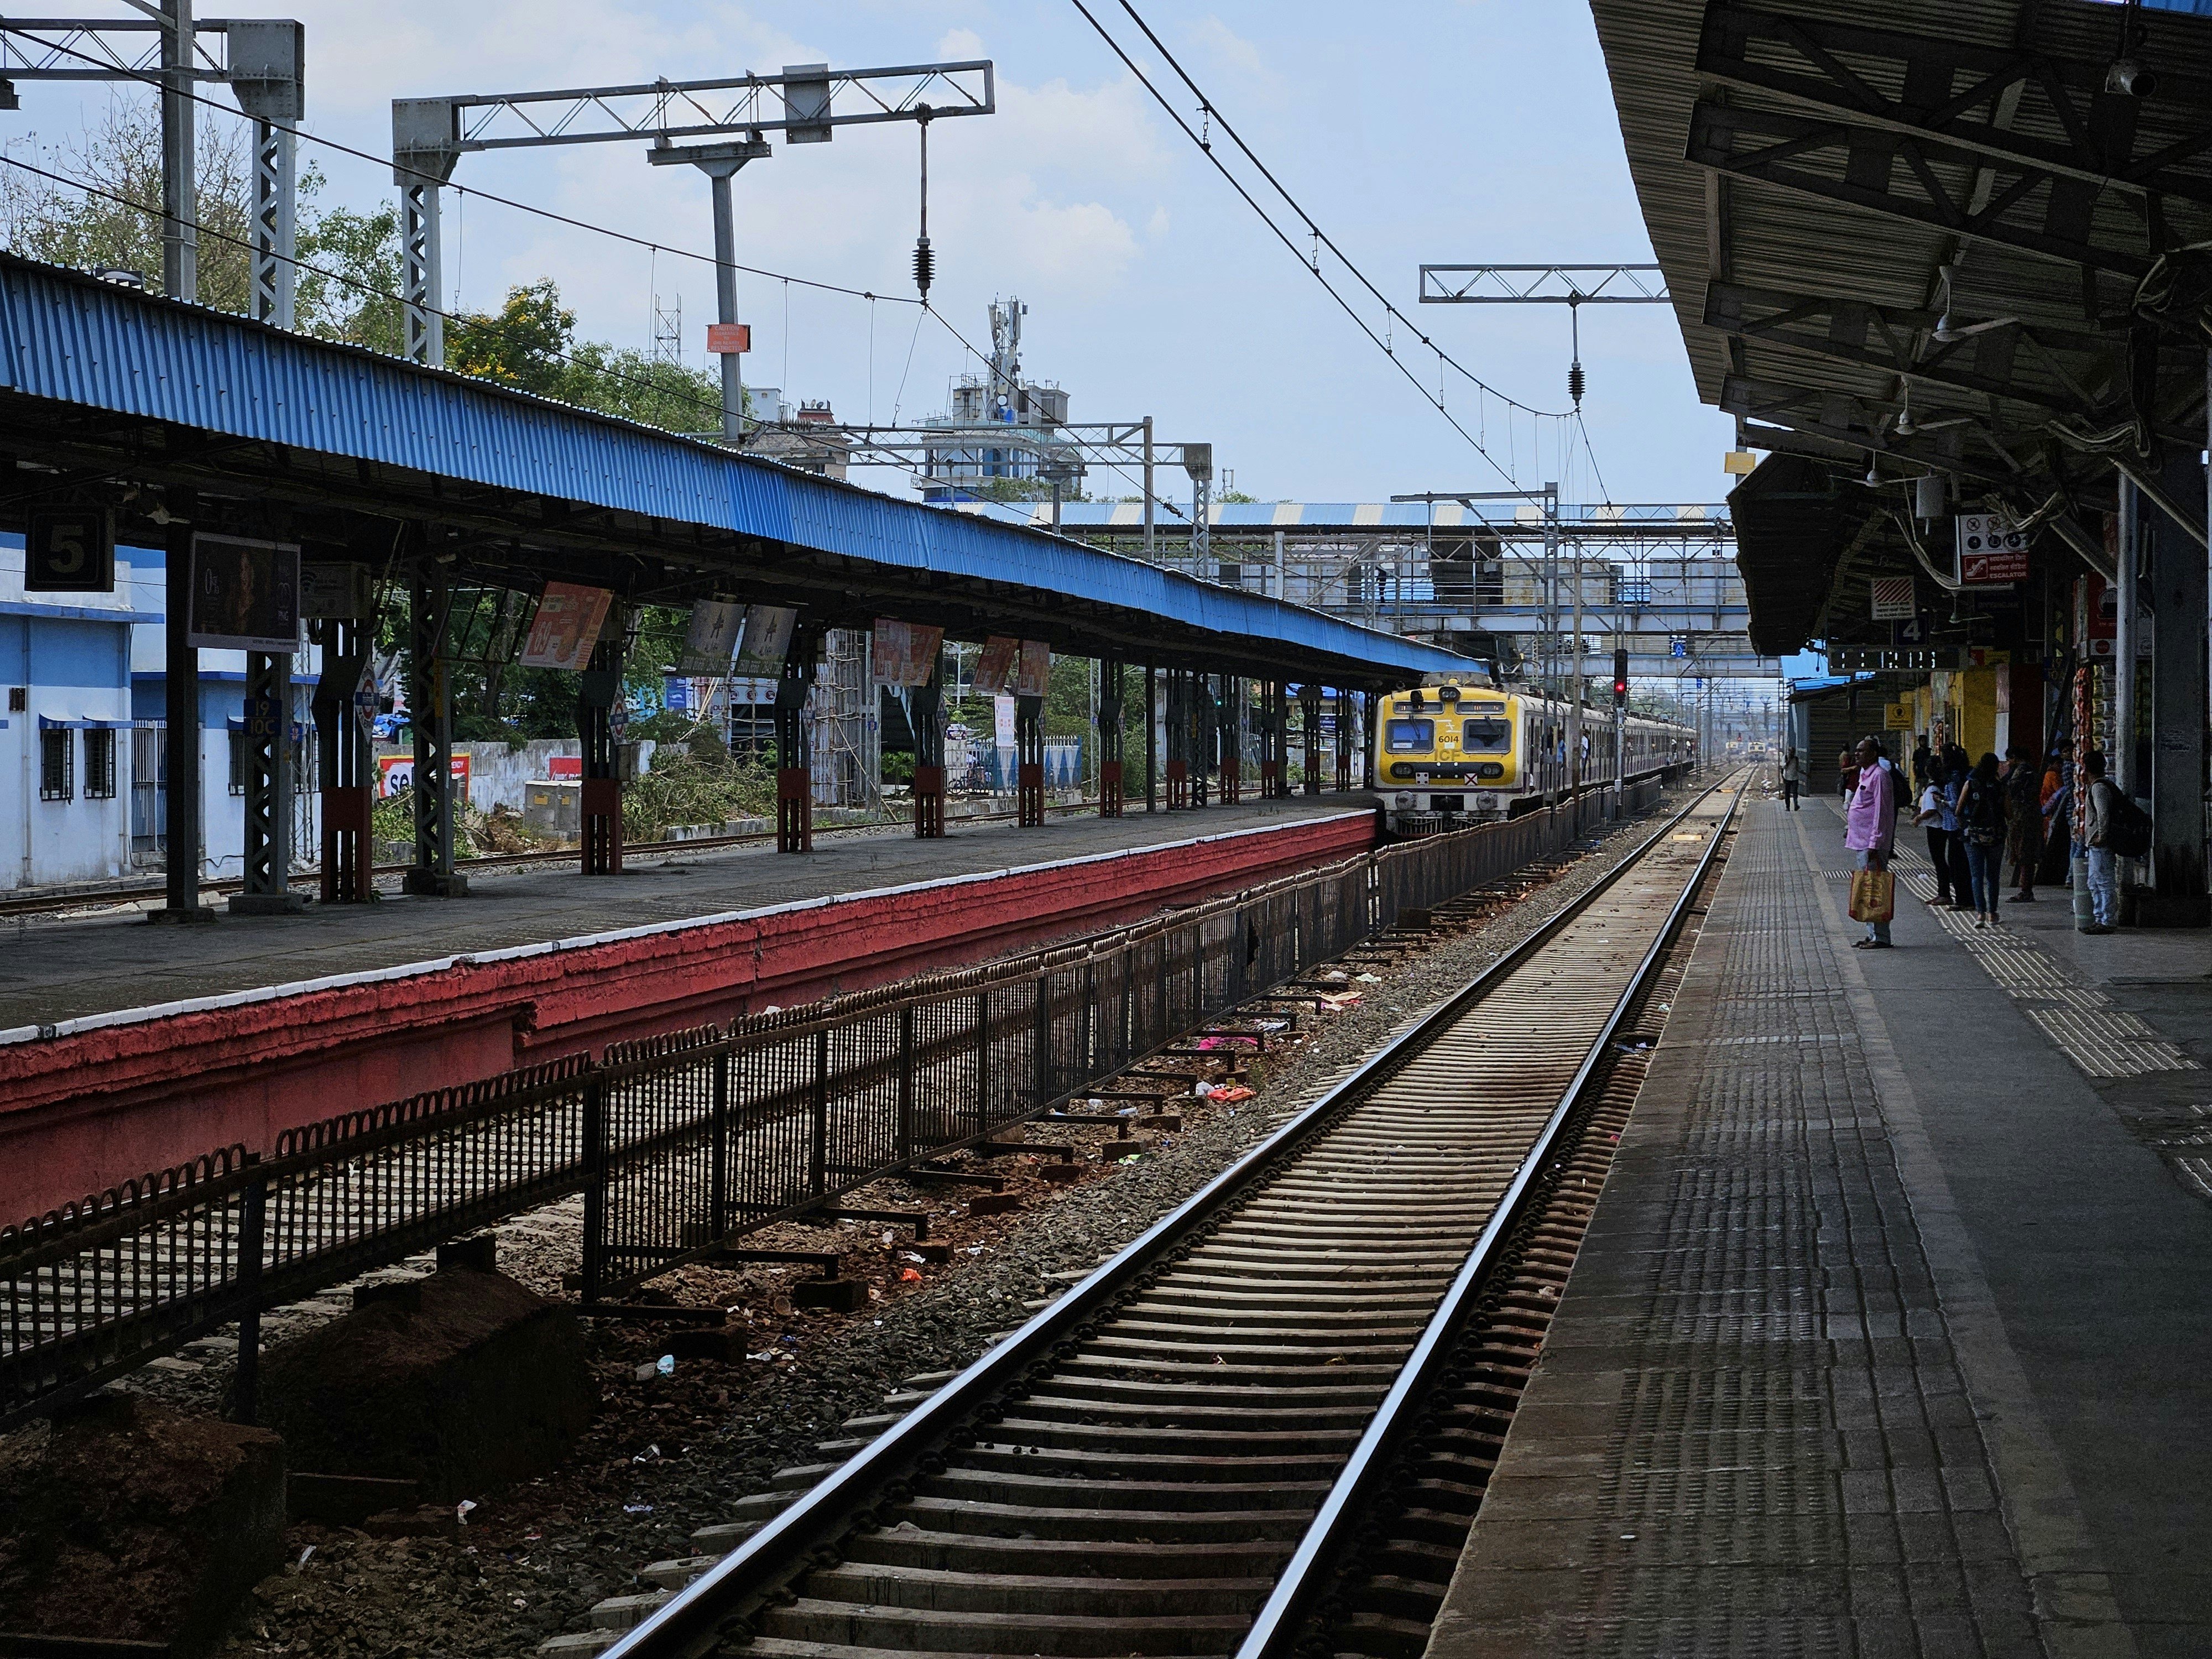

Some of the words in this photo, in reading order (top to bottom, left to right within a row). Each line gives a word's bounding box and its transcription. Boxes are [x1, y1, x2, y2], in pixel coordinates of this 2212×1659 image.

[48, 524, 85, 574] 5
[1989, 571, 2027, 579] ESCALATOR
[1902, 619, 1922, 641] 4
[255, 701, 270, 717] 19
[250, 718, 275, 735] 10C
[1434, 750, 1461, 761] ICF
